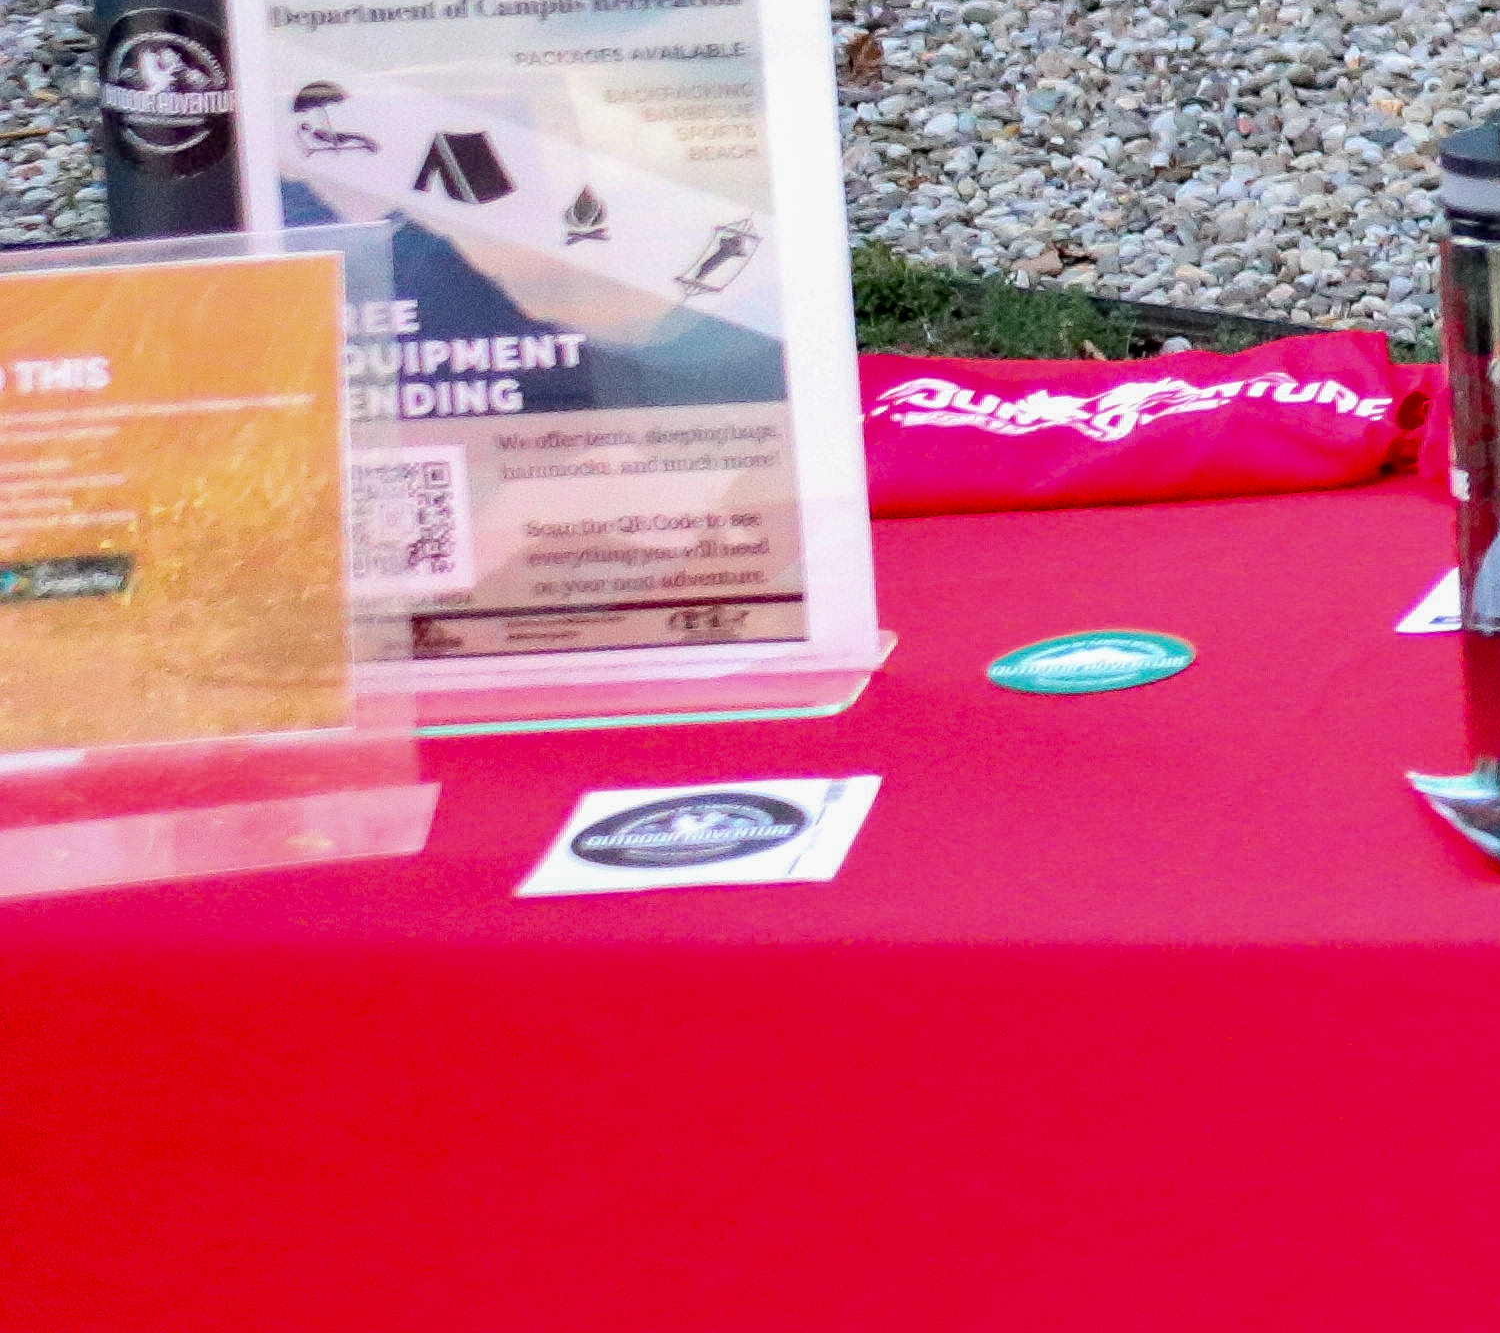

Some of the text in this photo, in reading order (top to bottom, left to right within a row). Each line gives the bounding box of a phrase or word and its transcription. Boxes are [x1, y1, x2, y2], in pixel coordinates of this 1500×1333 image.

[268, 1, 434, 32] Department
[630, 41, 746, 63] AVAILABLE
[343, 333, 587, 378] QUIPMENT
[13, 356, 111, 395] THIS
[347, 378, 525, 419] ENDING
